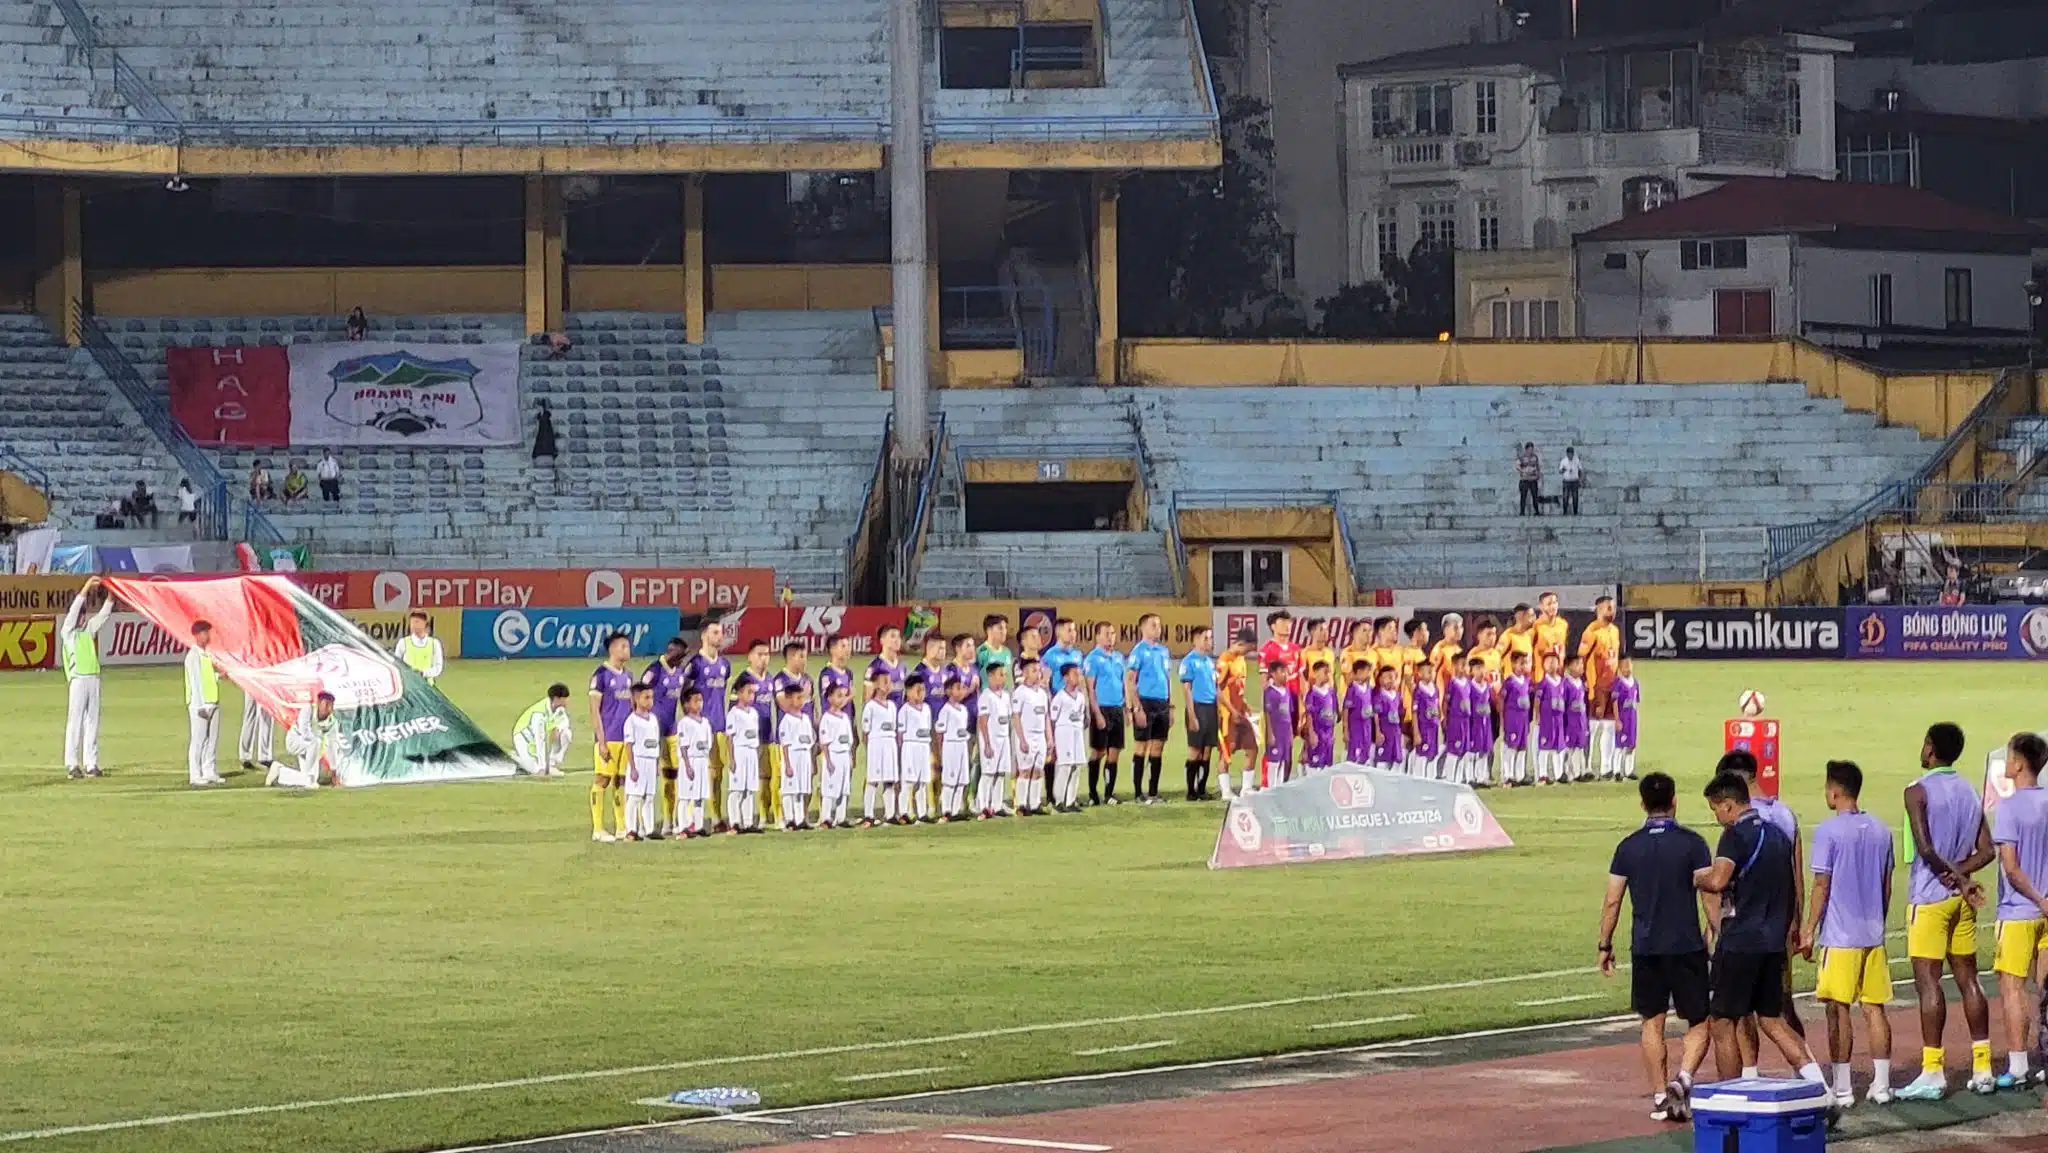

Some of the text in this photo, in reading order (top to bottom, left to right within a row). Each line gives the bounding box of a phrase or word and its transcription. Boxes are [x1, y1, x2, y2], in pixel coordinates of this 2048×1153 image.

[417, 578, 533, 608] FPT Play
[630, 578, 750, 608] FPT Play
[795, 606, 847, 634] K5
[1634, 610, 1839, 649] sk sumikura
[1902, 611, 1939, 637] BÓNG
[0, 620, 55, 665] K5
[535, 619, 649, 657] Casper
[1929, 641, 1979, 651] QUALITY
[1327, 811, 1382, 831] V.LEAGUE
[1396, 809, 1443, 826] 2023/24
